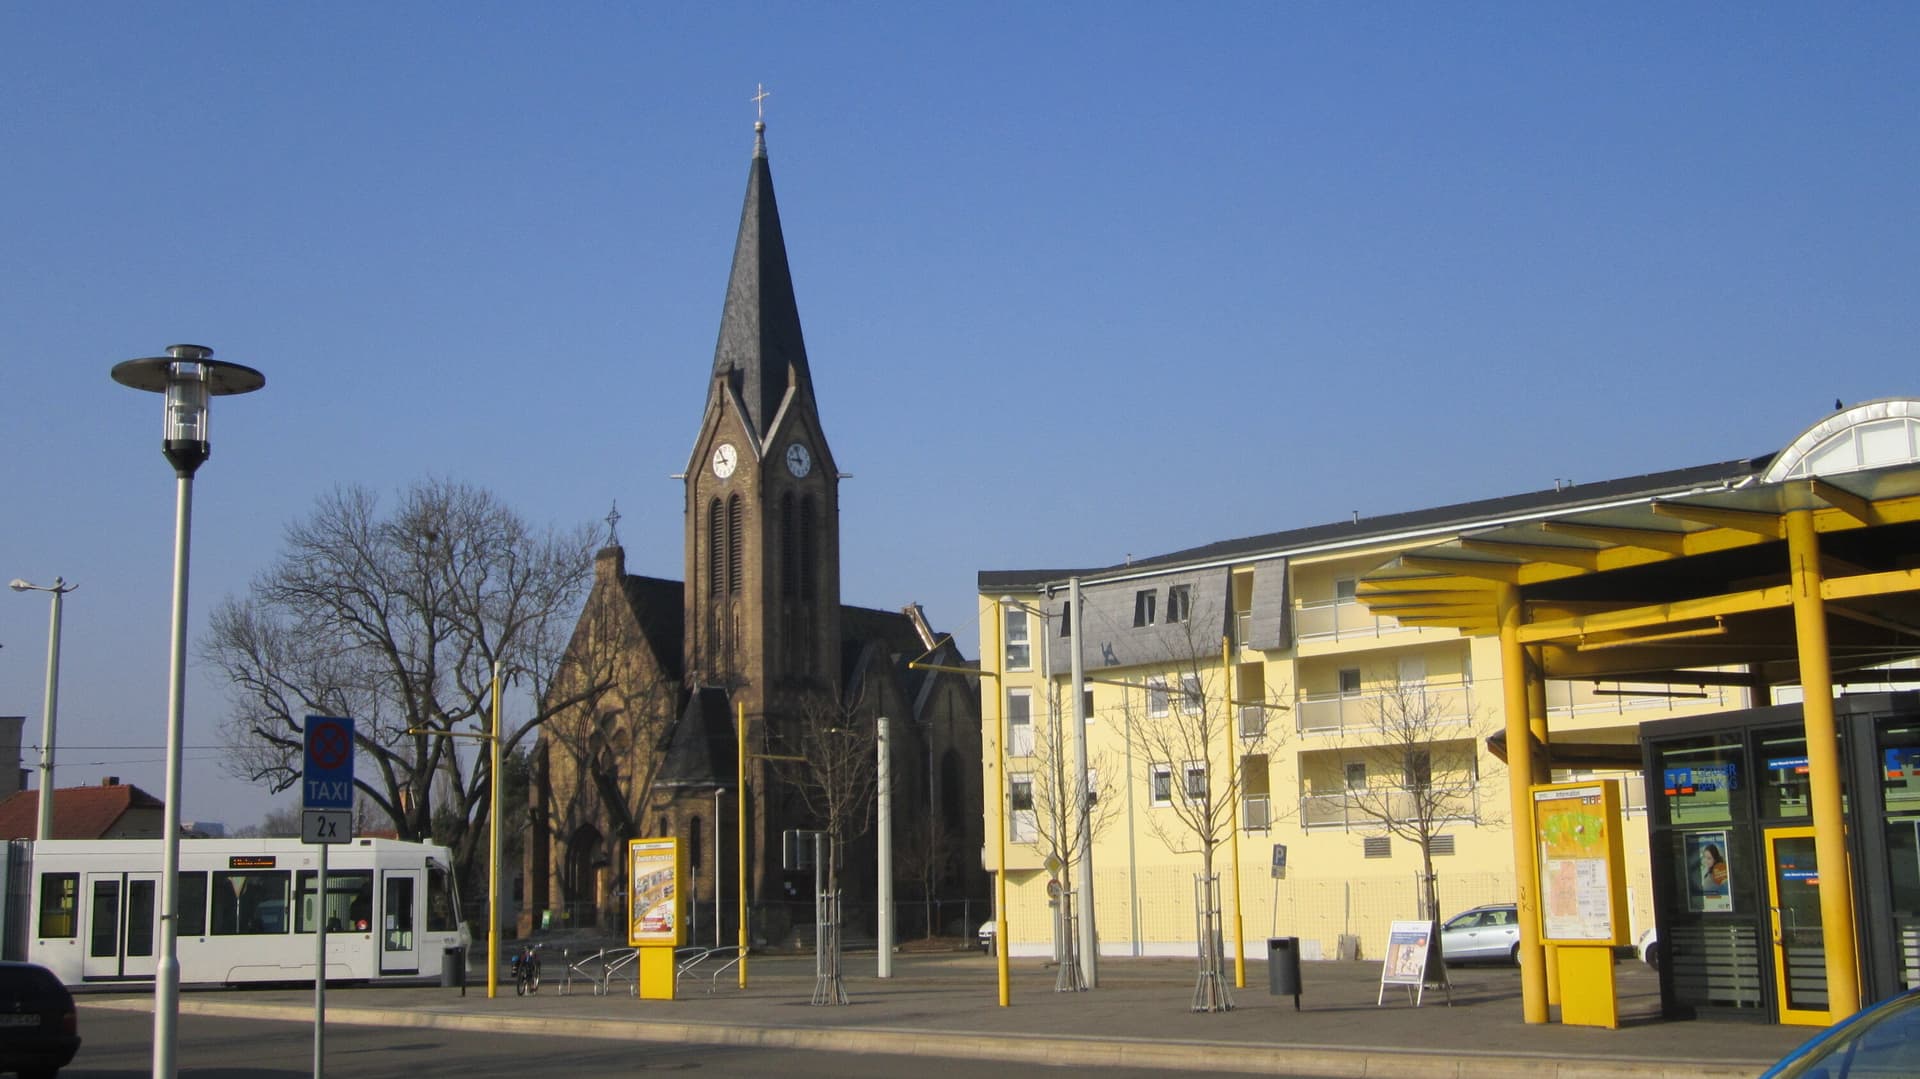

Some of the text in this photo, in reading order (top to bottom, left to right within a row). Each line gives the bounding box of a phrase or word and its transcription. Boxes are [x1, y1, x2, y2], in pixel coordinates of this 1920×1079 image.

[308, 780, 349, 801] TAXI
[317, 815, 337, 838] 2x
[1275, 847, 1284, 865] P
